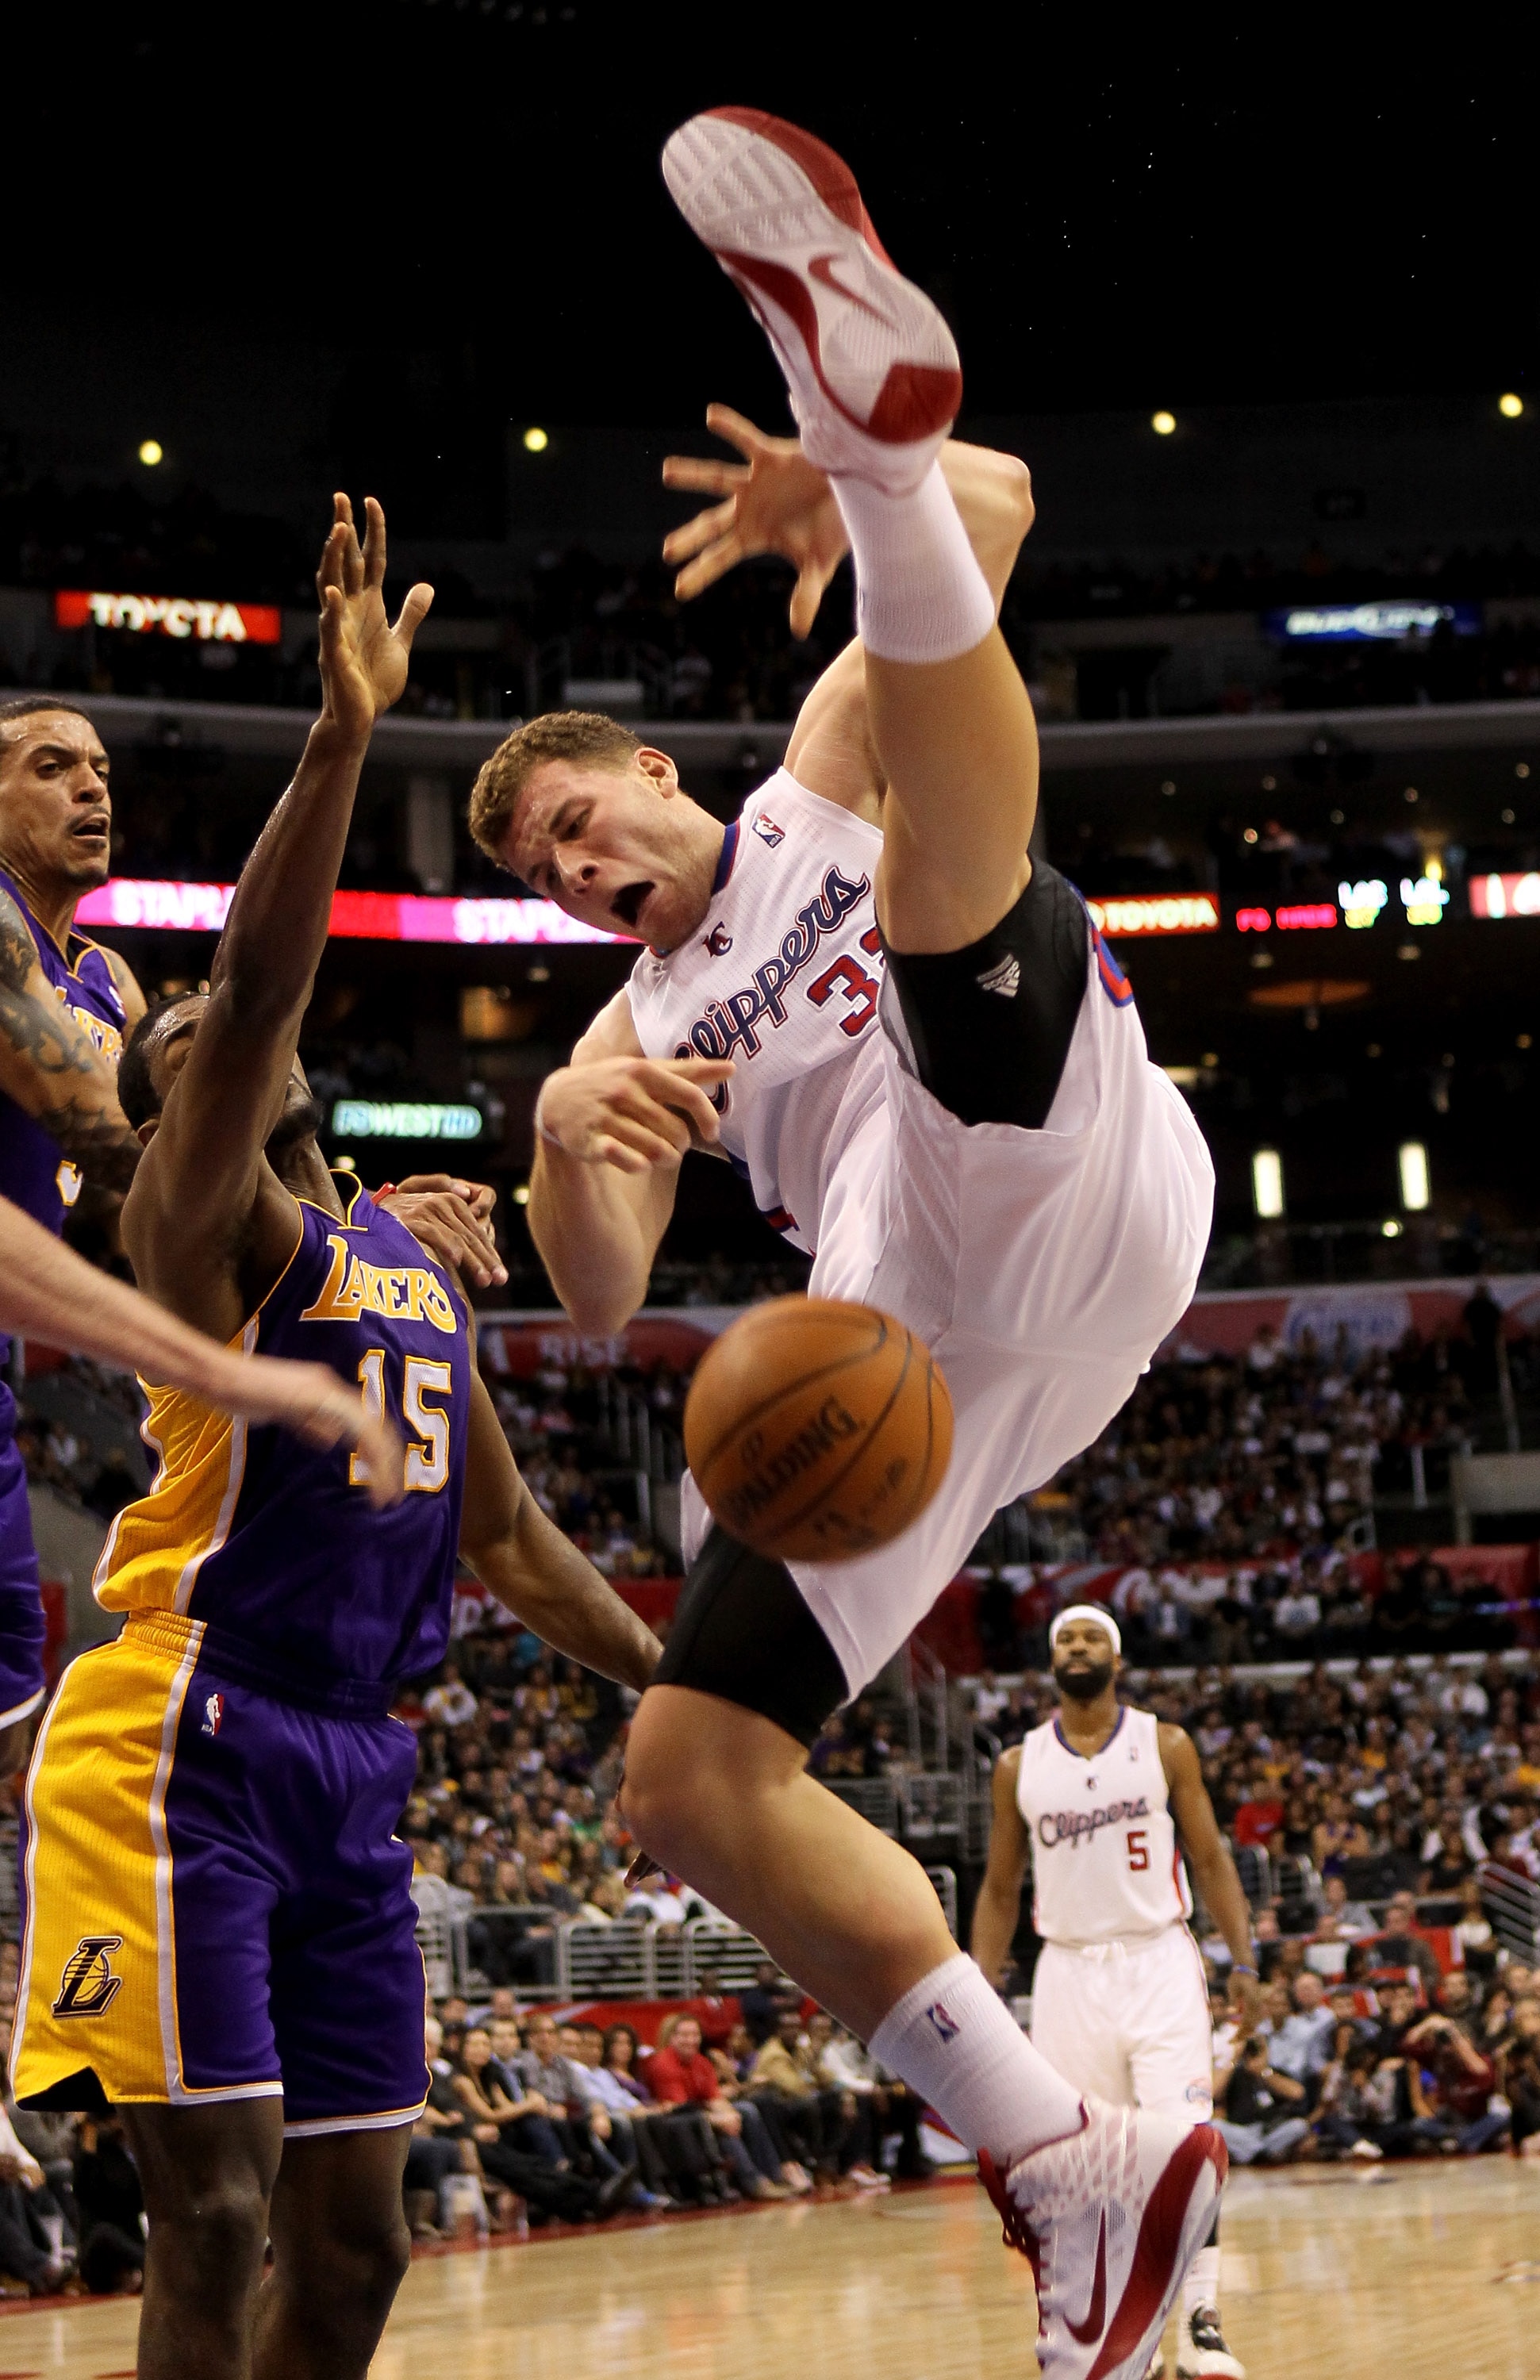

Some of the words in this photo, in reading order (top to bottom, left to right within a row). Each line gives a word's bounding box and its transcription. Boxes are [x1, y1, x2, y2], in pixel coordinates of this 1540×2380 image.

[1104, 896, 1219, 933] TOYOTA
[674, 865, 871, 1114] lippers
[298, 1234, 458, 1334] LAKERS
[349, 1349, 452, 1493] 15
[1039, 1797, 1150, 1849] Clippers
[1127, 1831, 1148, 1870] 5
